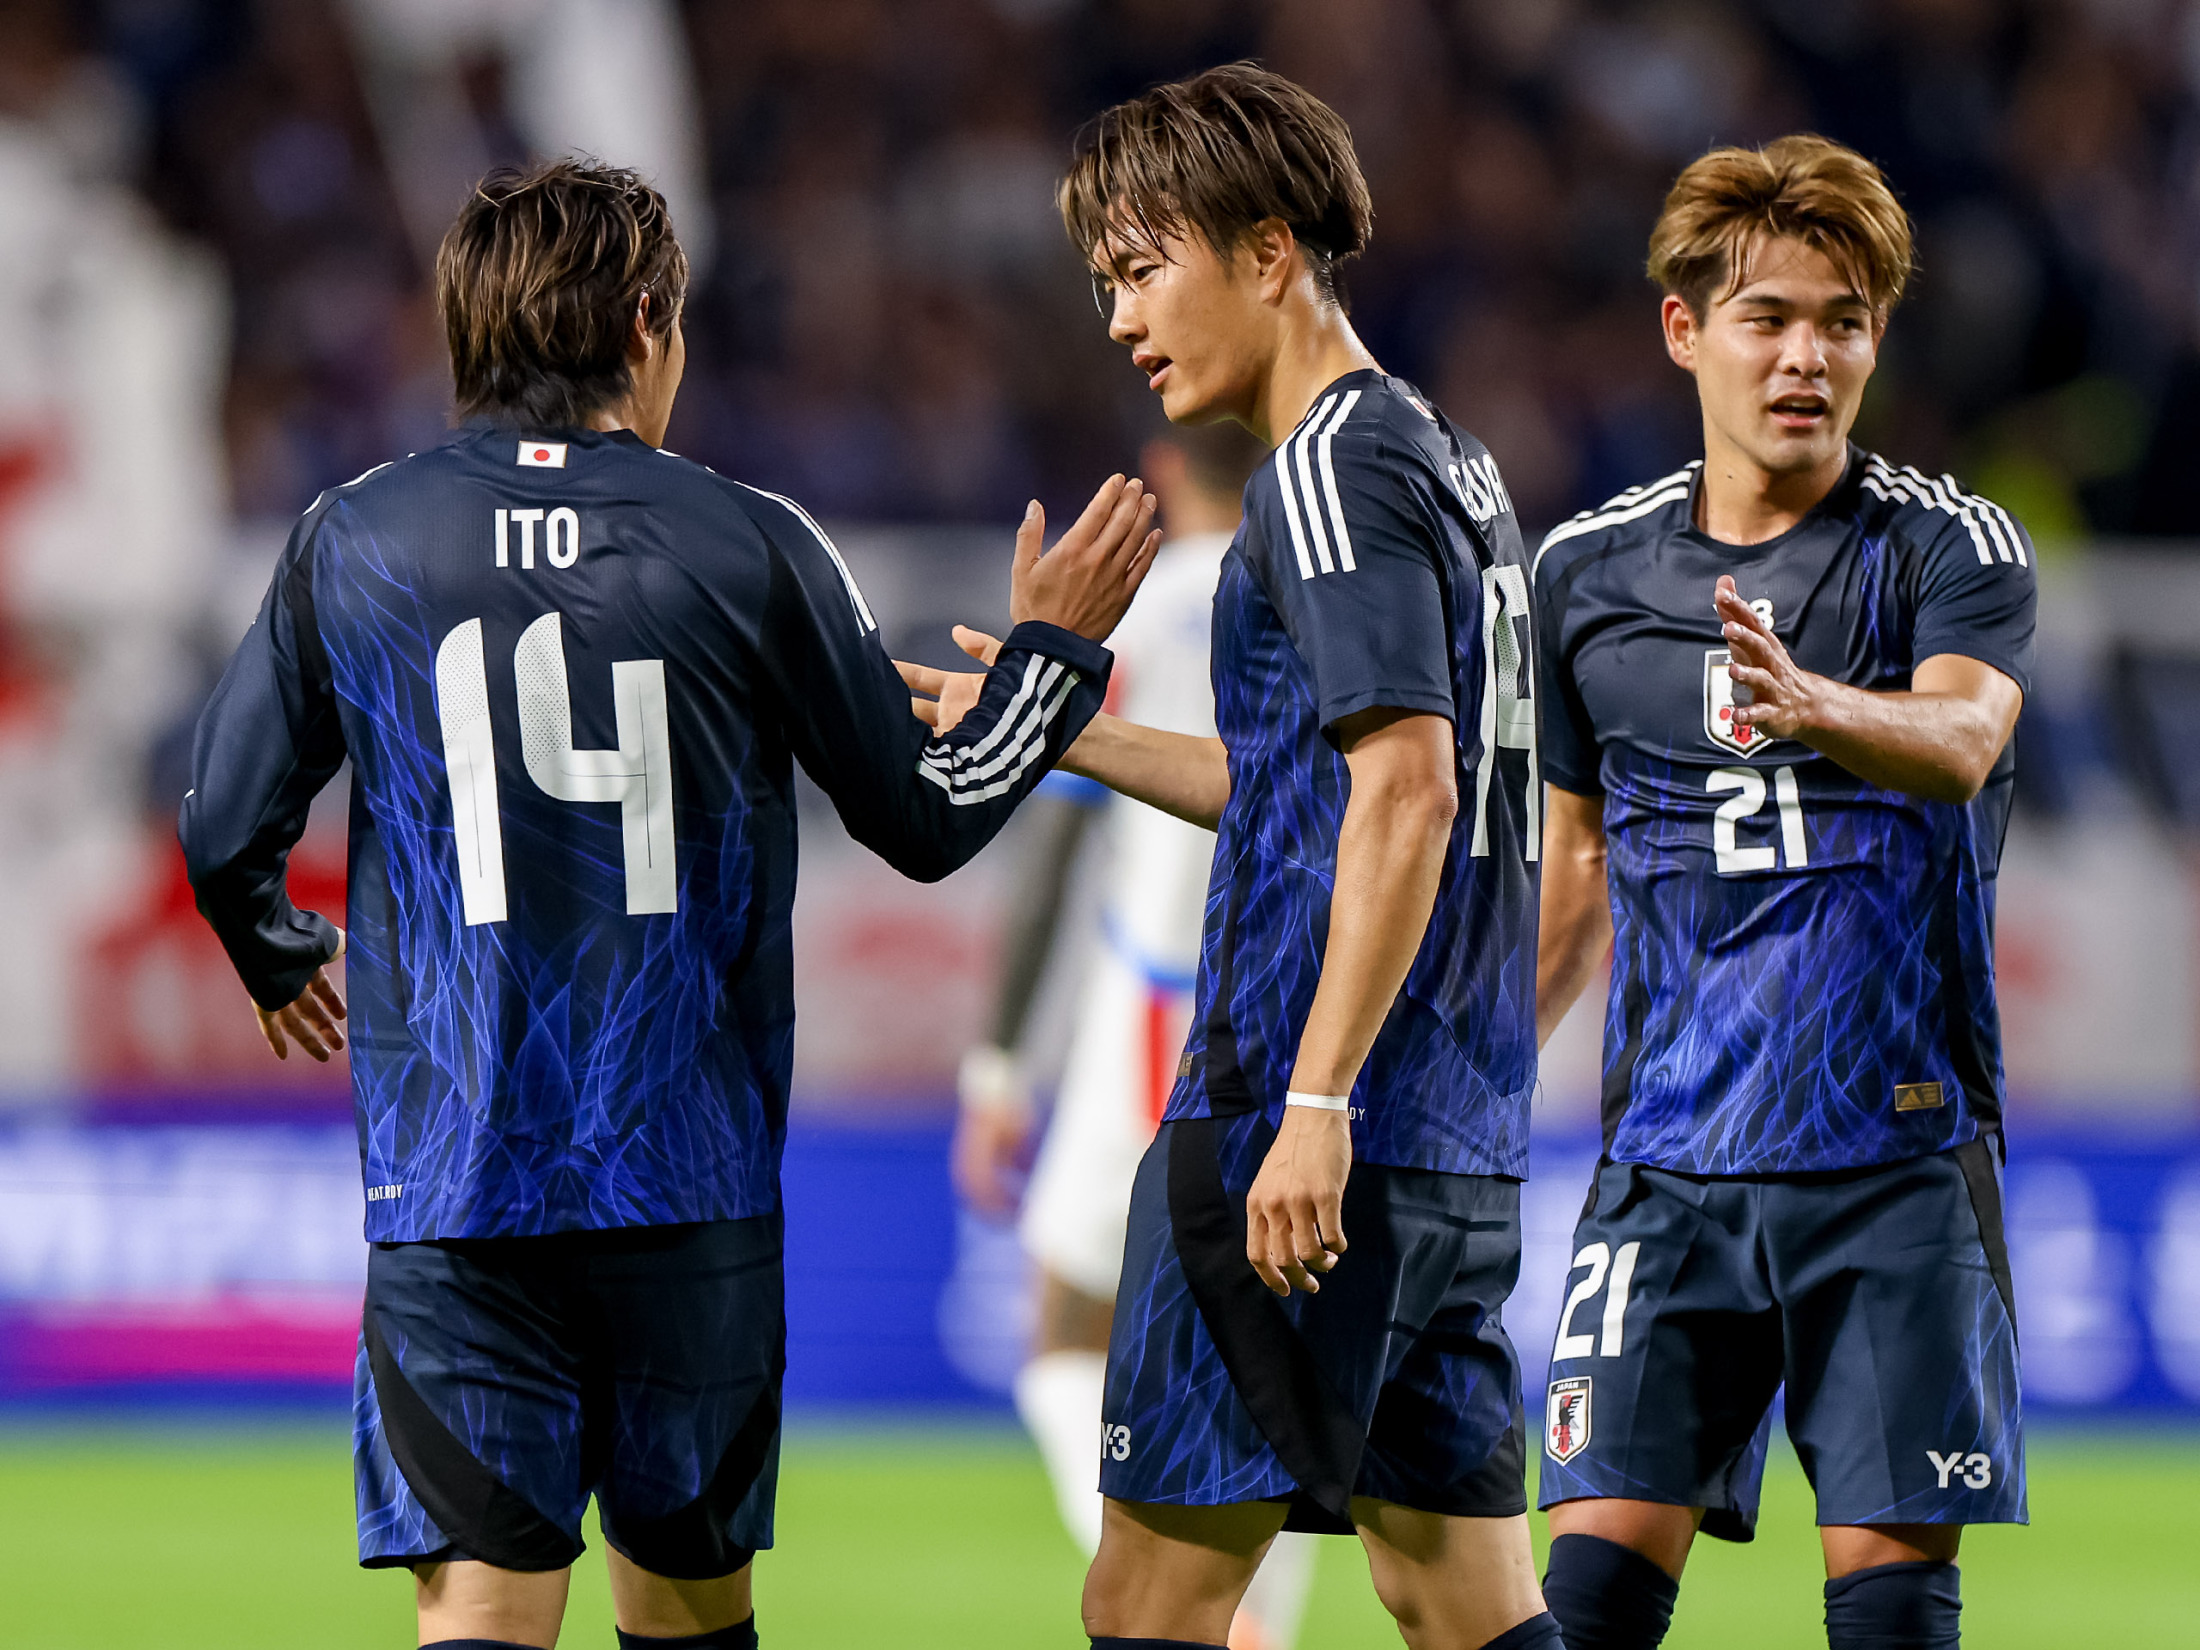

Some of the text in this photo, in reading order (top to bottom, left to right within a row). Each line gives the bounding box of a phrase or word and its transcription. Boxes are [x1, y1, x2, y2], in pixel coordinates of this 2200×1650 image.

[494, 506, 579, 569] ITO
[434, 610, 678, 927] 14
[1705, 764, 1809, 874] 21
[367, 1183, 403, 1202] HEAT.RDY
[1552, 1240, 1641, 1363] 21
[1101, 1421, 1132, 1462] Y-3
[1925, 1450, 1992, 1490] Y-3
